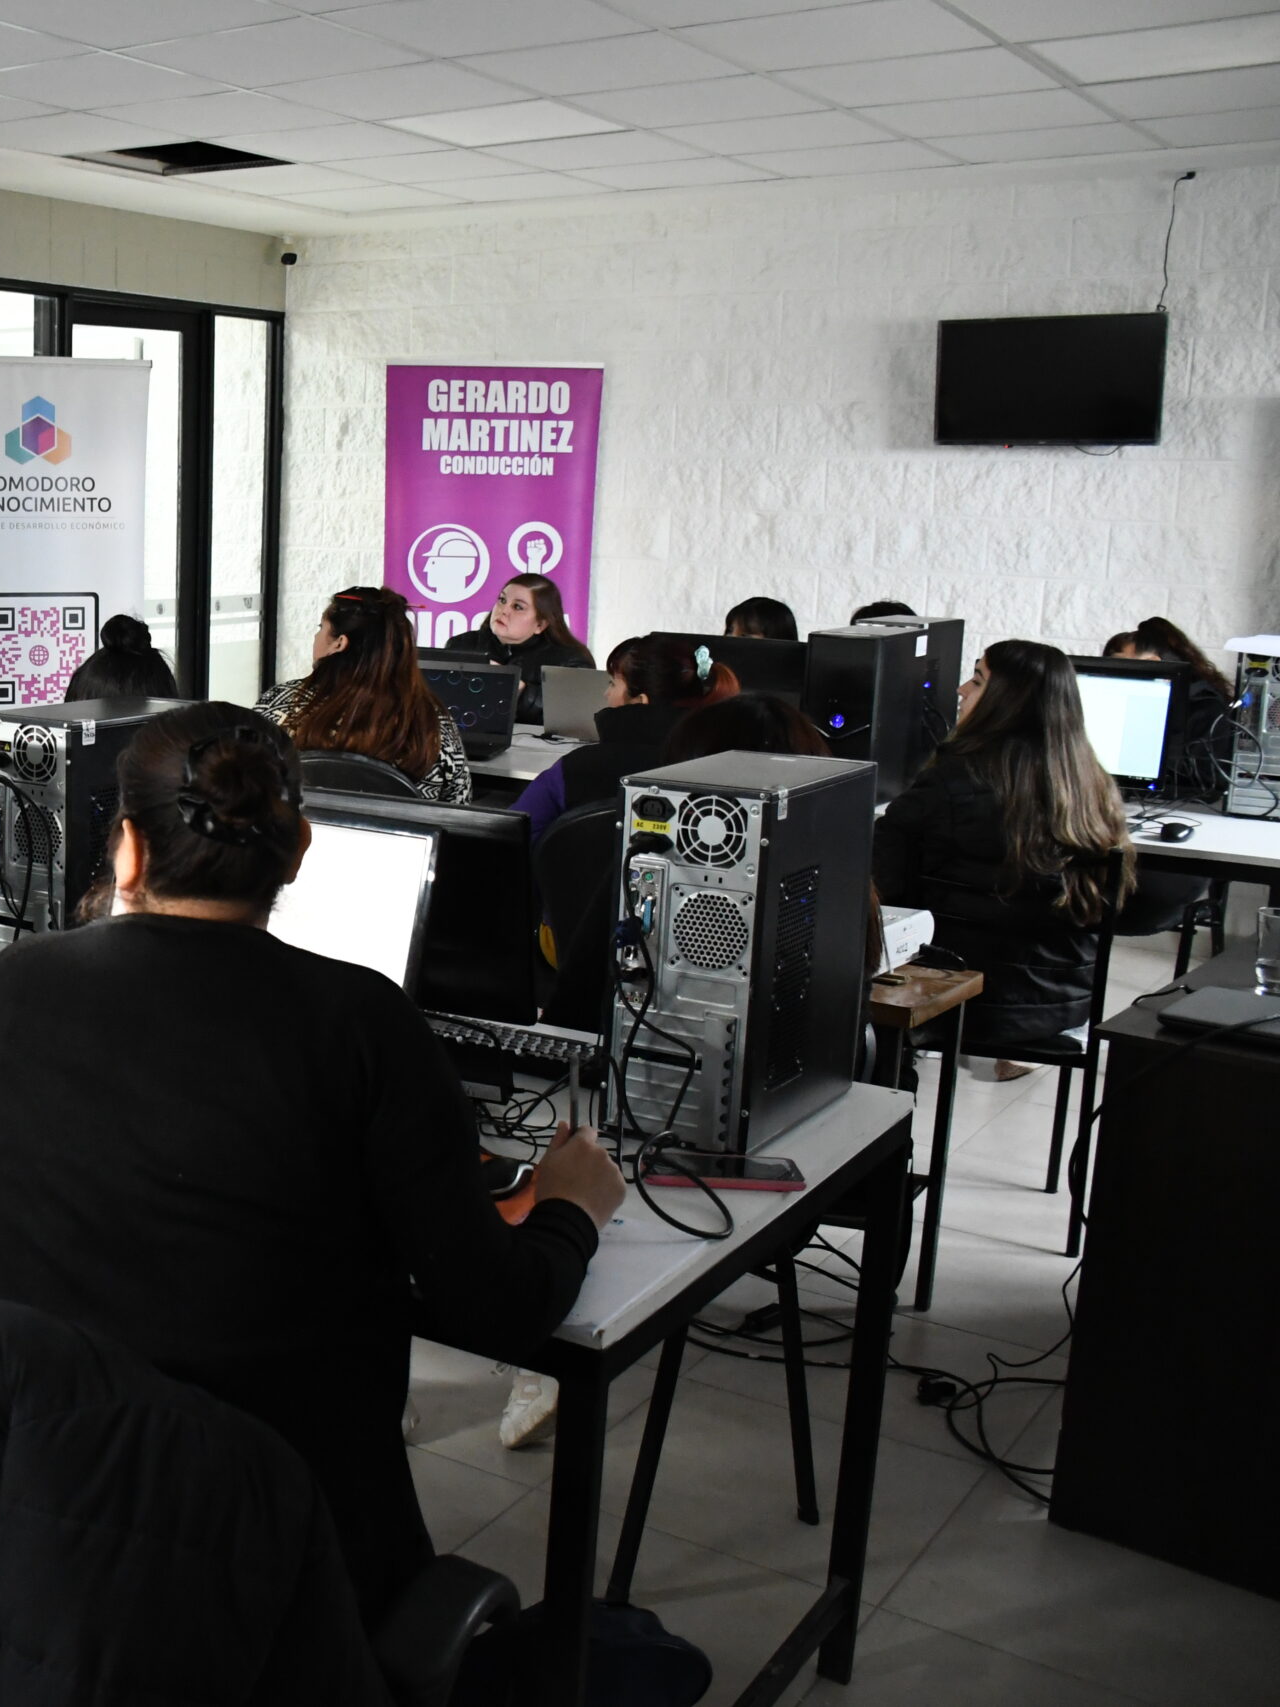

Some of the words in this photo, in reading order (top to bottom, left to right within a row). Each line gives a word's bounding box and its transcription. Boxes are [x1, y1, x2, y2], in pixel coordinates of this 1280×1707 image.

[427, 379, 570, 414] GERARDO
[422, 418, 574, 453] MARTINEZ
[440, 454, 554, 476] CONDUCCIÓN
[9, 521, 67, 531] DESARROLLO
